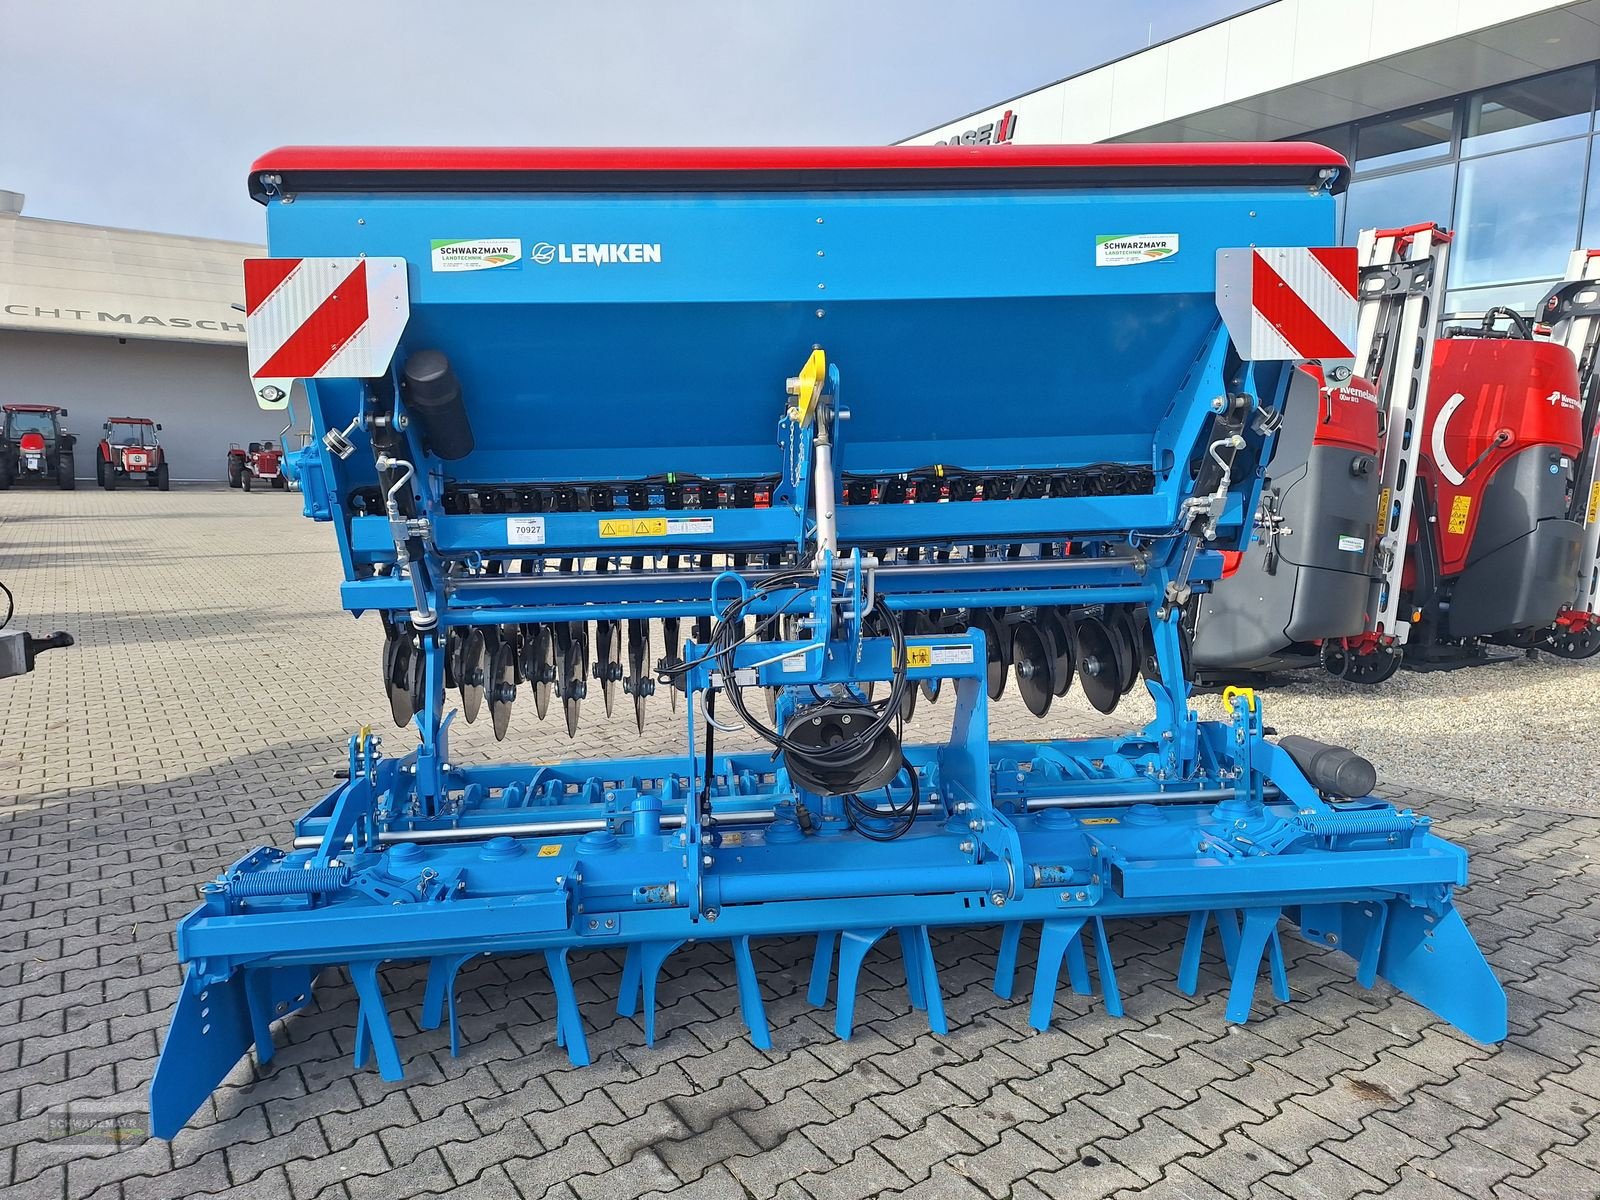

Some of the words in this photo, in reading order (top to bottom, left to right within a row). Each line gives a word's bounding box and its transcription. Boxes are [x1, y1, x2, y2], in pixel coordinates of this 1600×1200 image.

[934, 123, 994, 146] ASE
[1104, 241, 1167, 250] SCHWARZMAYR
[440, 247, 509, 255] SCHWARZMAYR
[558, 243, 662, 267] LEMKEN
[516, 526, 541, 534] 70927
